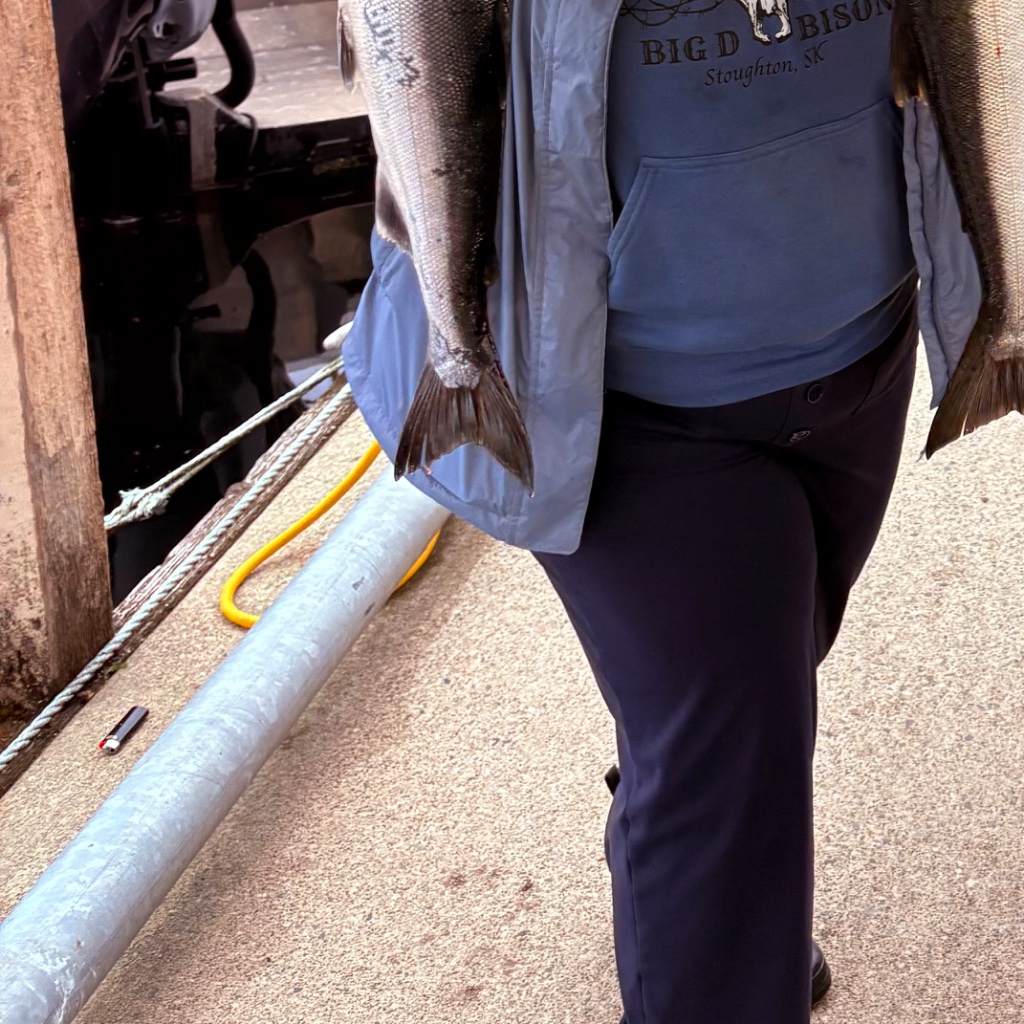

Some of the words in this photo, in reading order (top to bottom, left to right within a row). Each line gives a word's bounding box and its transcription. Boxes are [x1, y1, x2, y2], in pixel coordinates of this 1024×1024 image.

[639, 36, 708, 66] BIG
[715, 29, 741, 58] D
[704, 56, 798, 88] Stoughton,
[804, 39, 829, 69] SK
